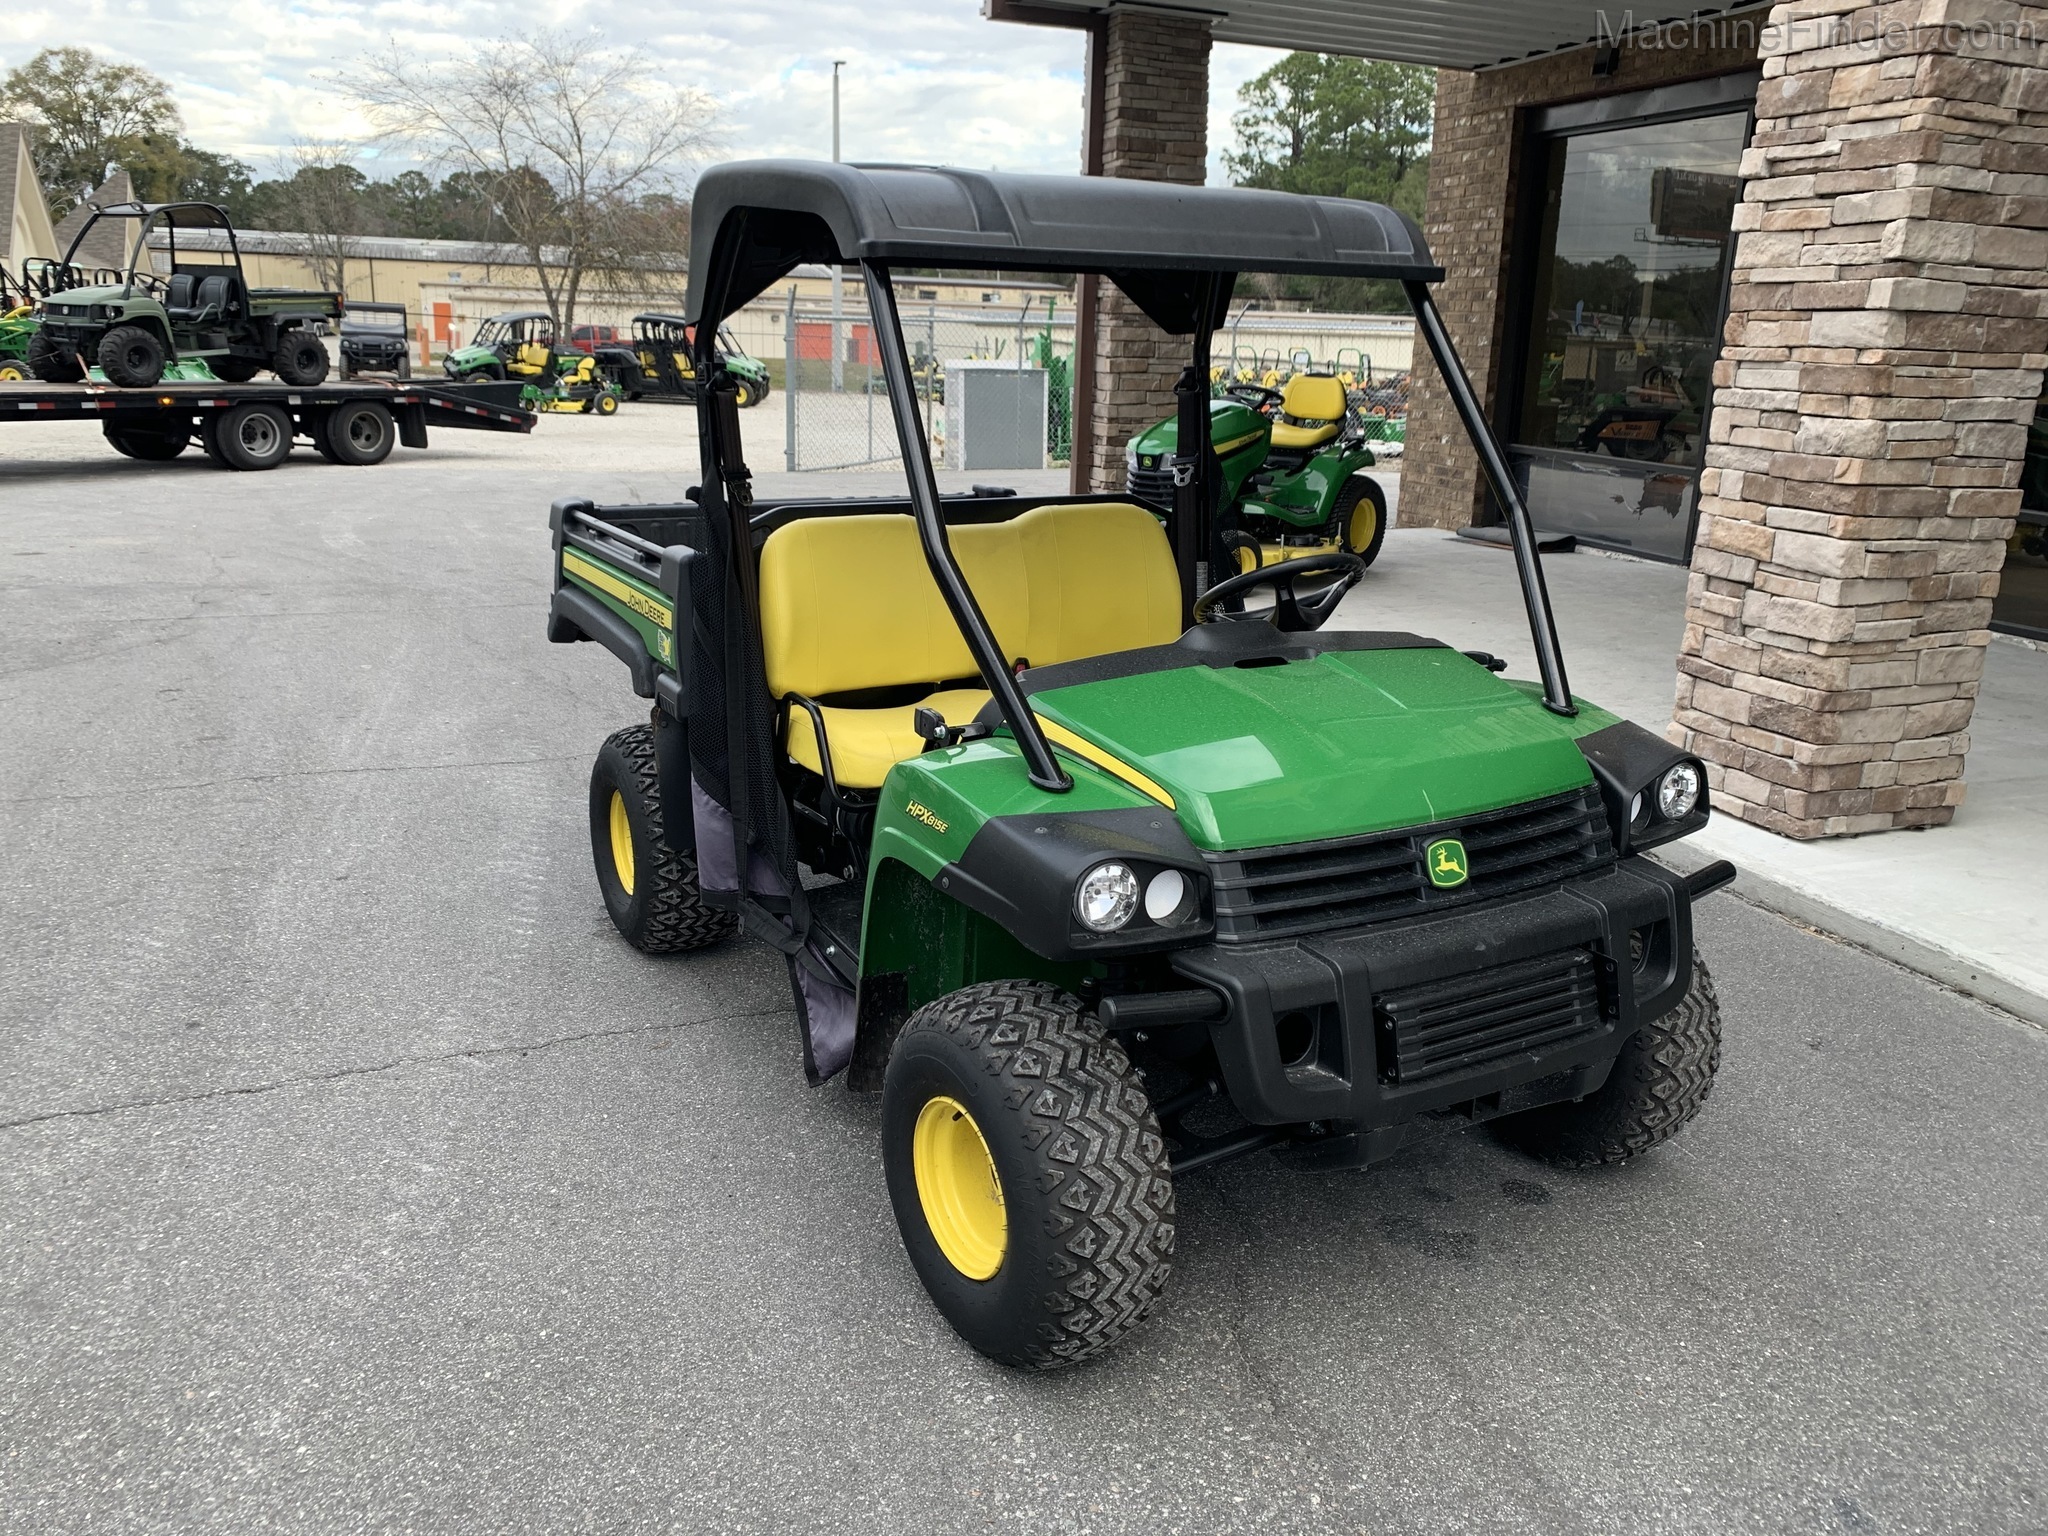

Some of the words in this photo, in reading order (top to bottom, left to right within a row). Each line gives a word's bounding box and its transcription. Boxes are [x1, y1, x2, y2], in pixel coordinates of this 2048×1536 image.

[627, 590, 644, 613] JOHN
[643, 599, 665, 627] DEERE
[905, 800, 949, 834] HPX815E
